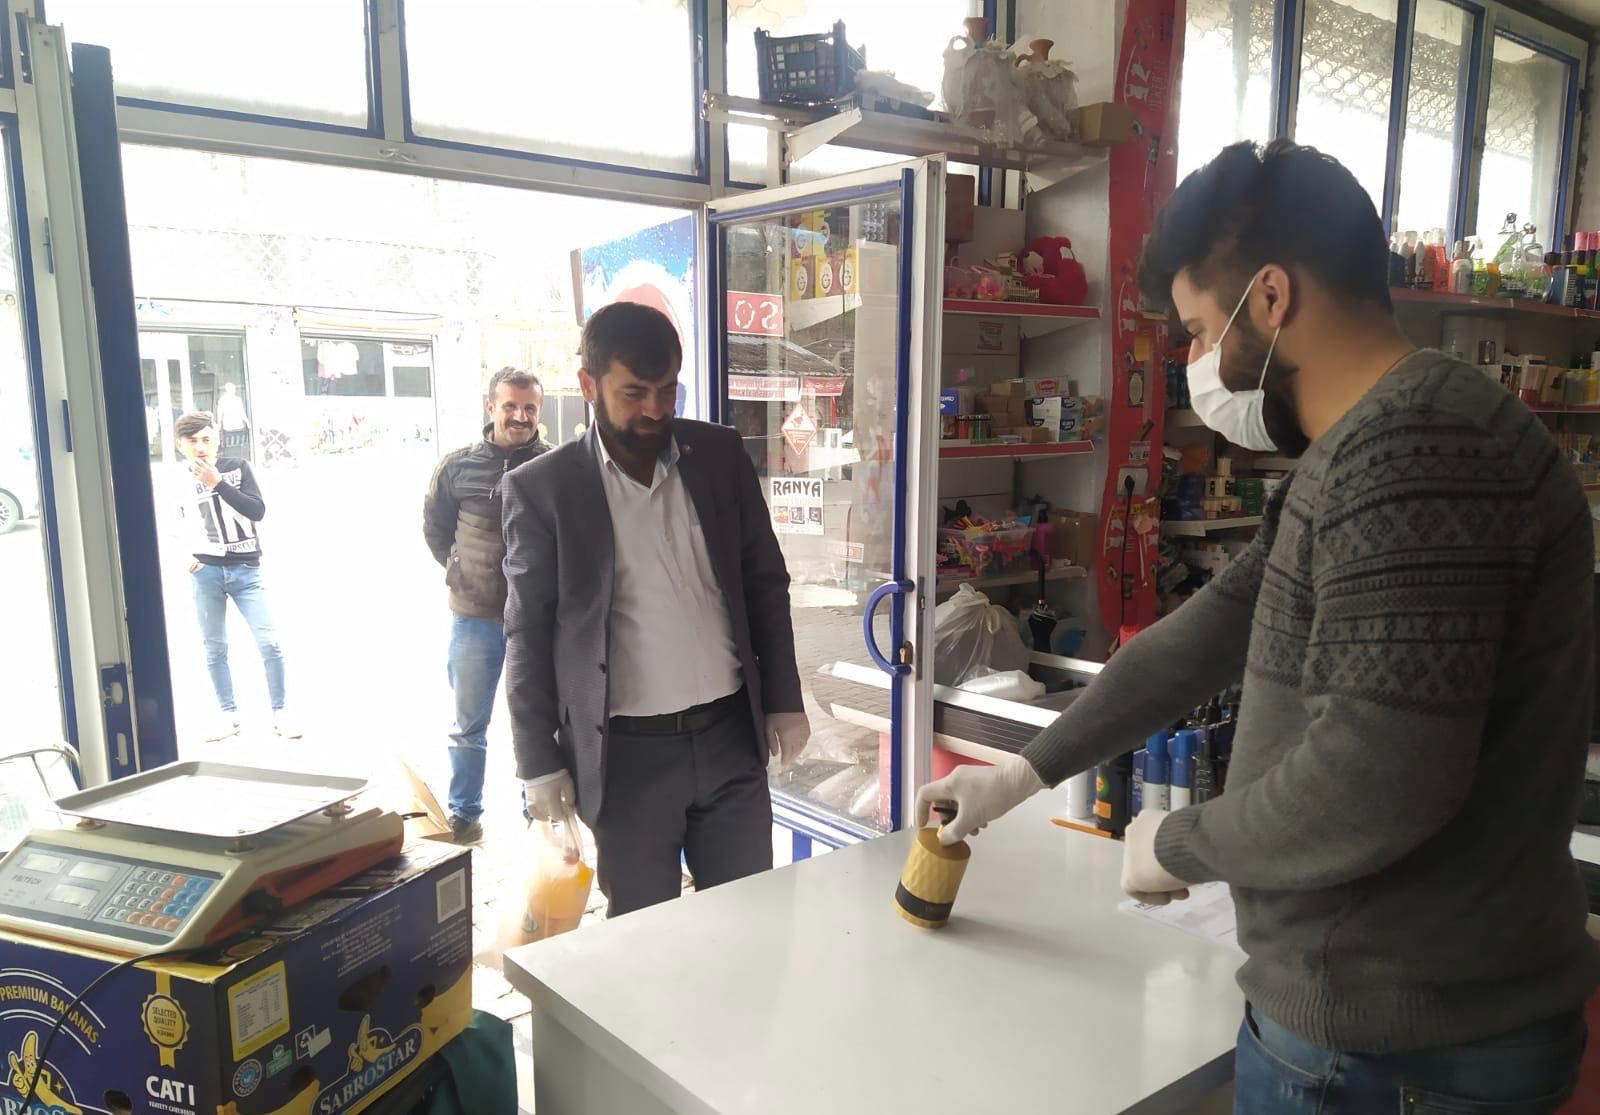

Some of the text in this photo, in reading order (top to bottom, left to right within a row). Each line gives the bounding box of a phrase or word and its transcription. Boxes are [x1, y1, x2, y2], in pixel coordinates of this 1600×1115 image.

[773, 480, 821, 497] RANYA
[0, 985, 49, 1005] PREMIUM
[151, 1006, 177, 1019] SELECTED
[152, 1015, 177, 1027] QUALITY
[319, 1036, 416, 1115] SABROSTAR
[145, 1074, 185, 1103] CAT
